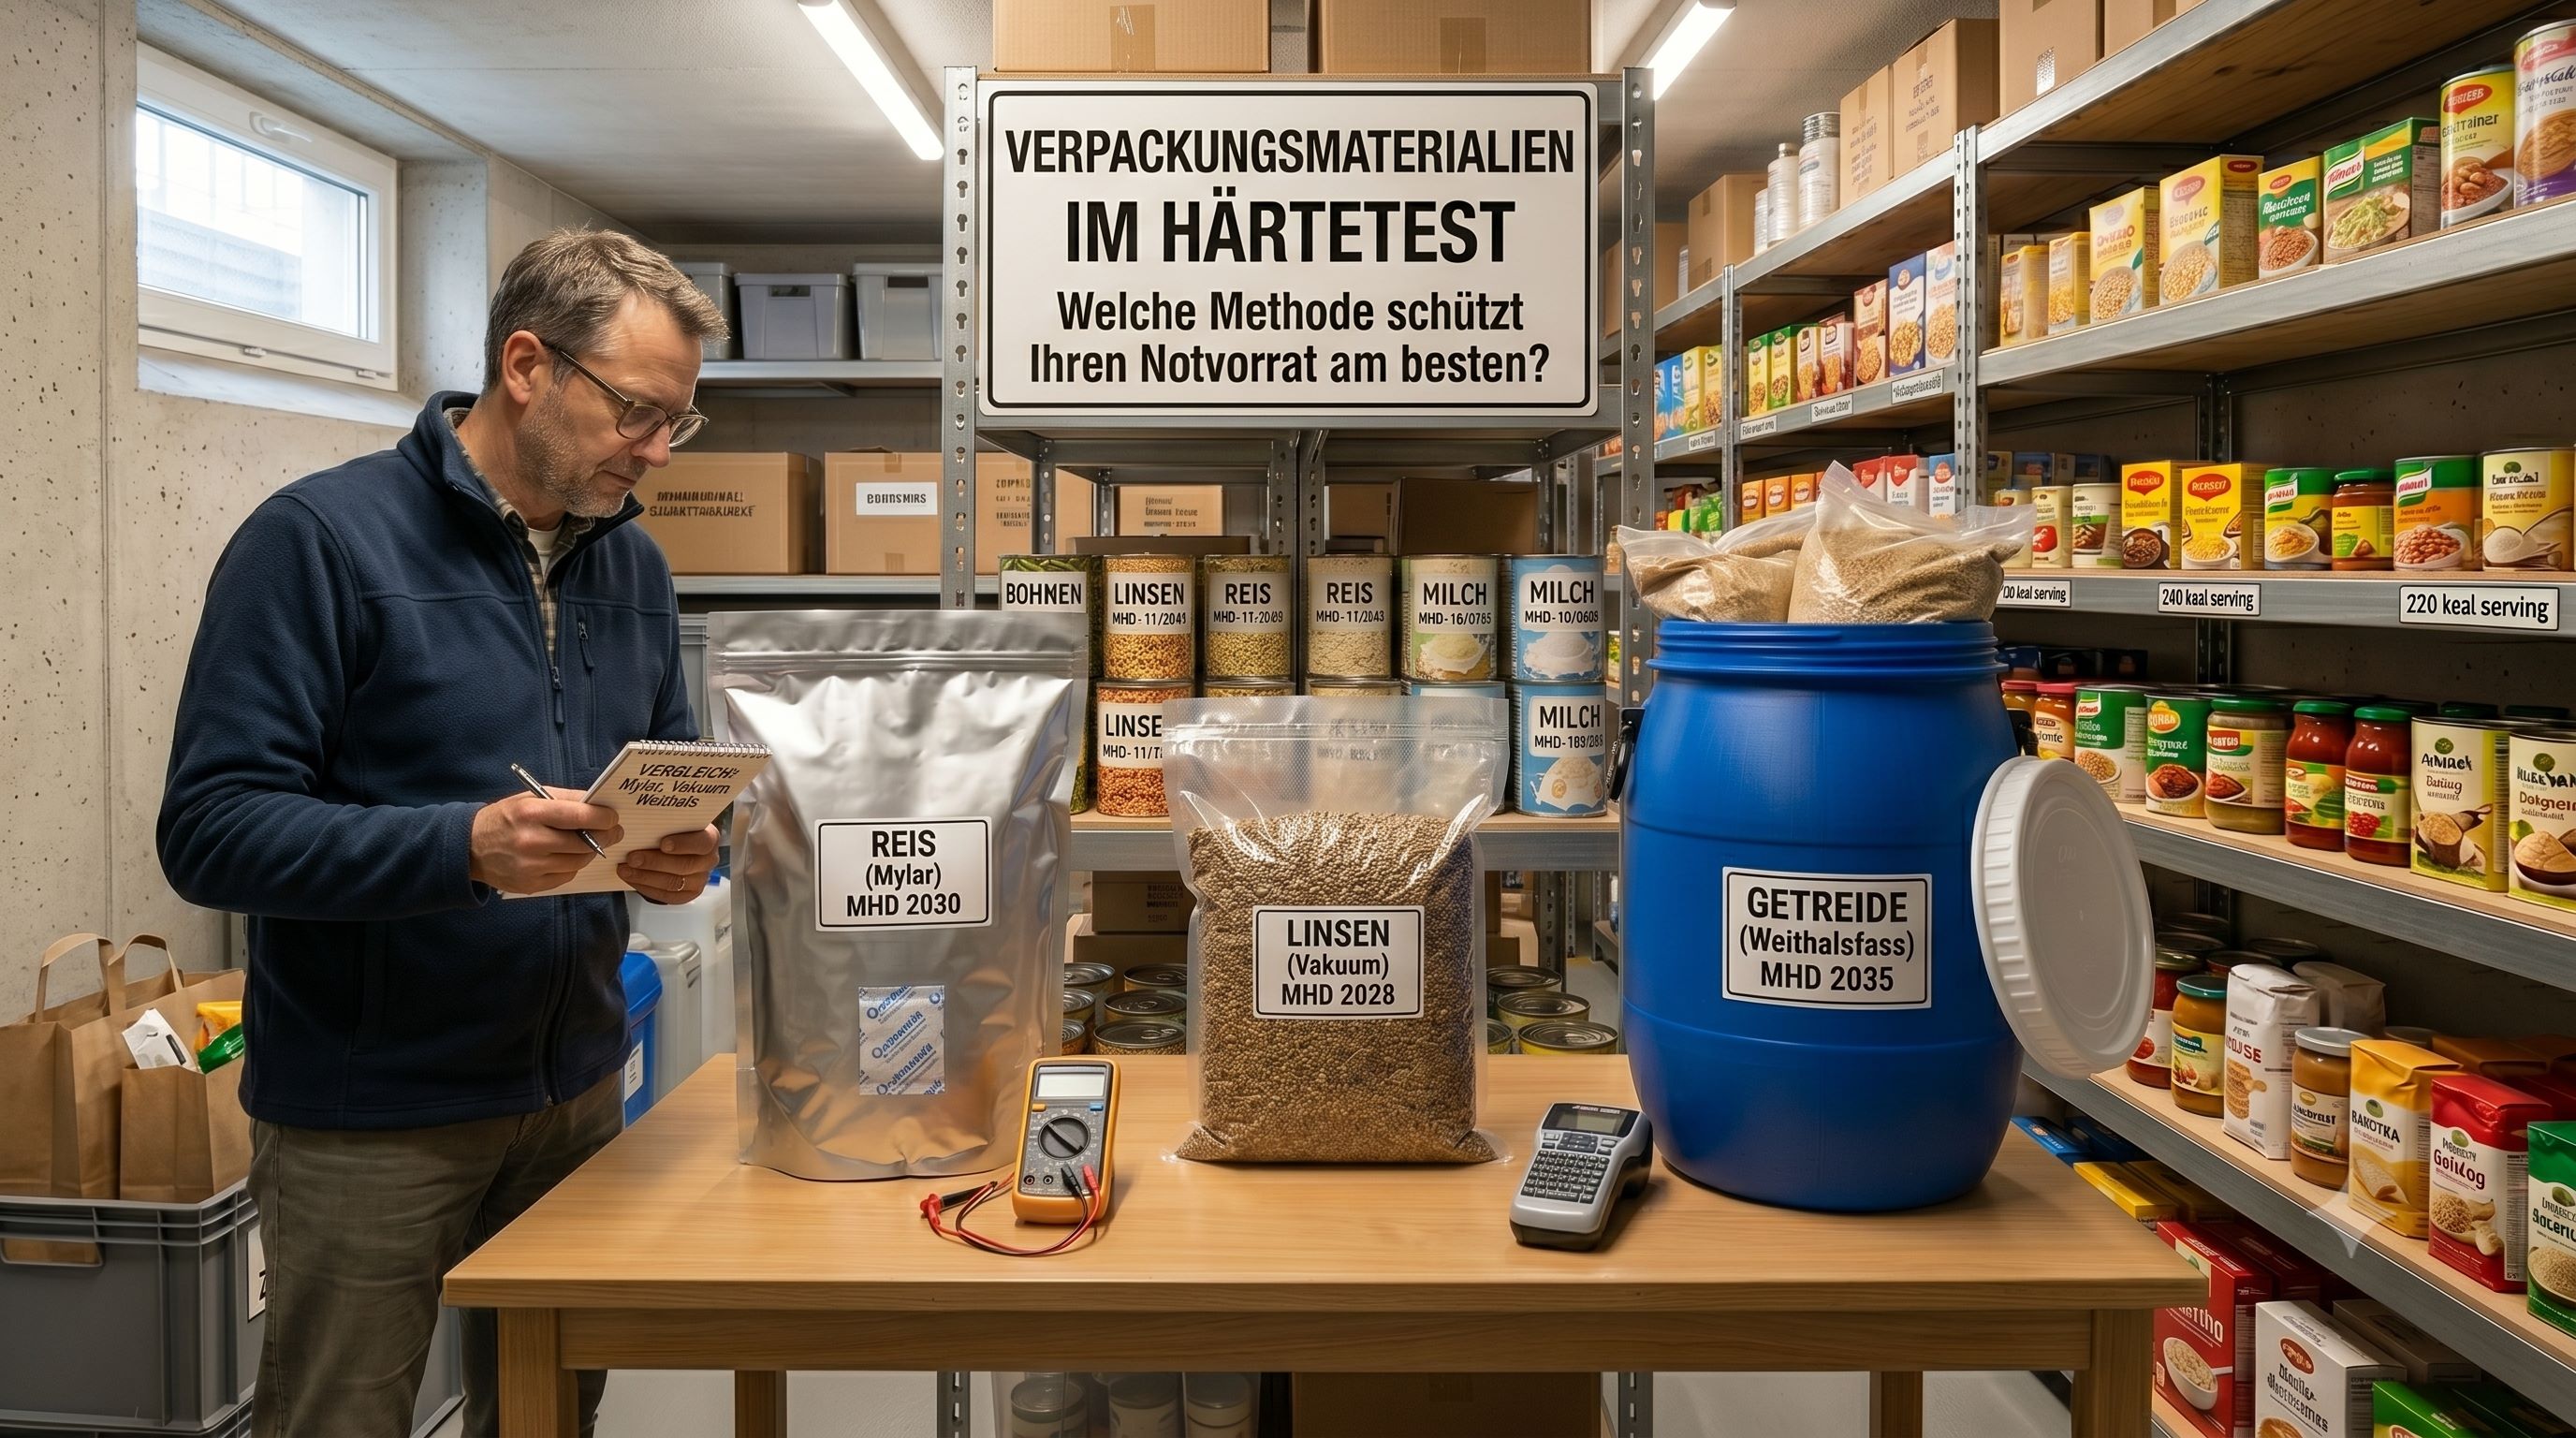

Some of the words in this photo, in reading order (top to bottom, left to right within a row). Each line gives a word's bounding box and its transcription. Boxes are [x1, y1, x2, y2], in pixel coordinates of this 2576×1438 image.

[1005, 129, 1574, 174] VERPACKUNGSMATERIALIEN
[1066, 200, 1137, 262] IM
[1164, 186, 1516, 263] HÄRTETEST
[1057, 291, 1196, 330] Welche
[1211, 291, 1374, 330] Methode
[1386, 291, 1524, 330] schützt
[1031, 343, 1126, 383] Ihren
[1141, 343, 1318, 383] Notvorrat
[1330, 354, 1387, 383] am
[1401, 343, 1550, 383] besten?
[1115, 582, 1184, 605] LINSEN
[1225, 582, 1271, 605] REIS
[1326, 581, 1373, 604] REIS
[1423, 582, 1486, 606] MILCH
[1530, 580, 1594, 604] MILCH
[2034, 586, 2067, 603] serving
[2162, 589, 2183, 606] 240
[2210, 590, 2254, 611] serving
[2407, 594, 2437, 613] 220
[2443, 594, 2476, 615] keal
[2481, 595, 2550, 624] serving
[1105, 713, 1163, 737] LINSE
[1540, 705, 1601, 729] MILCH
[619, 778, 664, 795] Mylar,
[672, 780, 731, 795] Vakuum
[636, 795, 700, 808] Weithals
[871, 829, 936, 858] REIS
[866, 862, 942, 891] (Mylar)
[847, 895, 899, 917] MHD
[907, 892, 960, 916] 2030
[1748, 887, 1908, 923] GETREIDE
[1287, 919, 1389, 946] LINSEN
[1740, 924, 1914, 962] (Weithalsfass)
[1288, 953, 1389, 980] (Vakuum)
[1761, 961, 1822, 990] MHD
[1831, 966, 1894, 991] 2035
[1281, 984, 1333, 1005] MHD
[1340, 984, 1395, 1005] 2028
